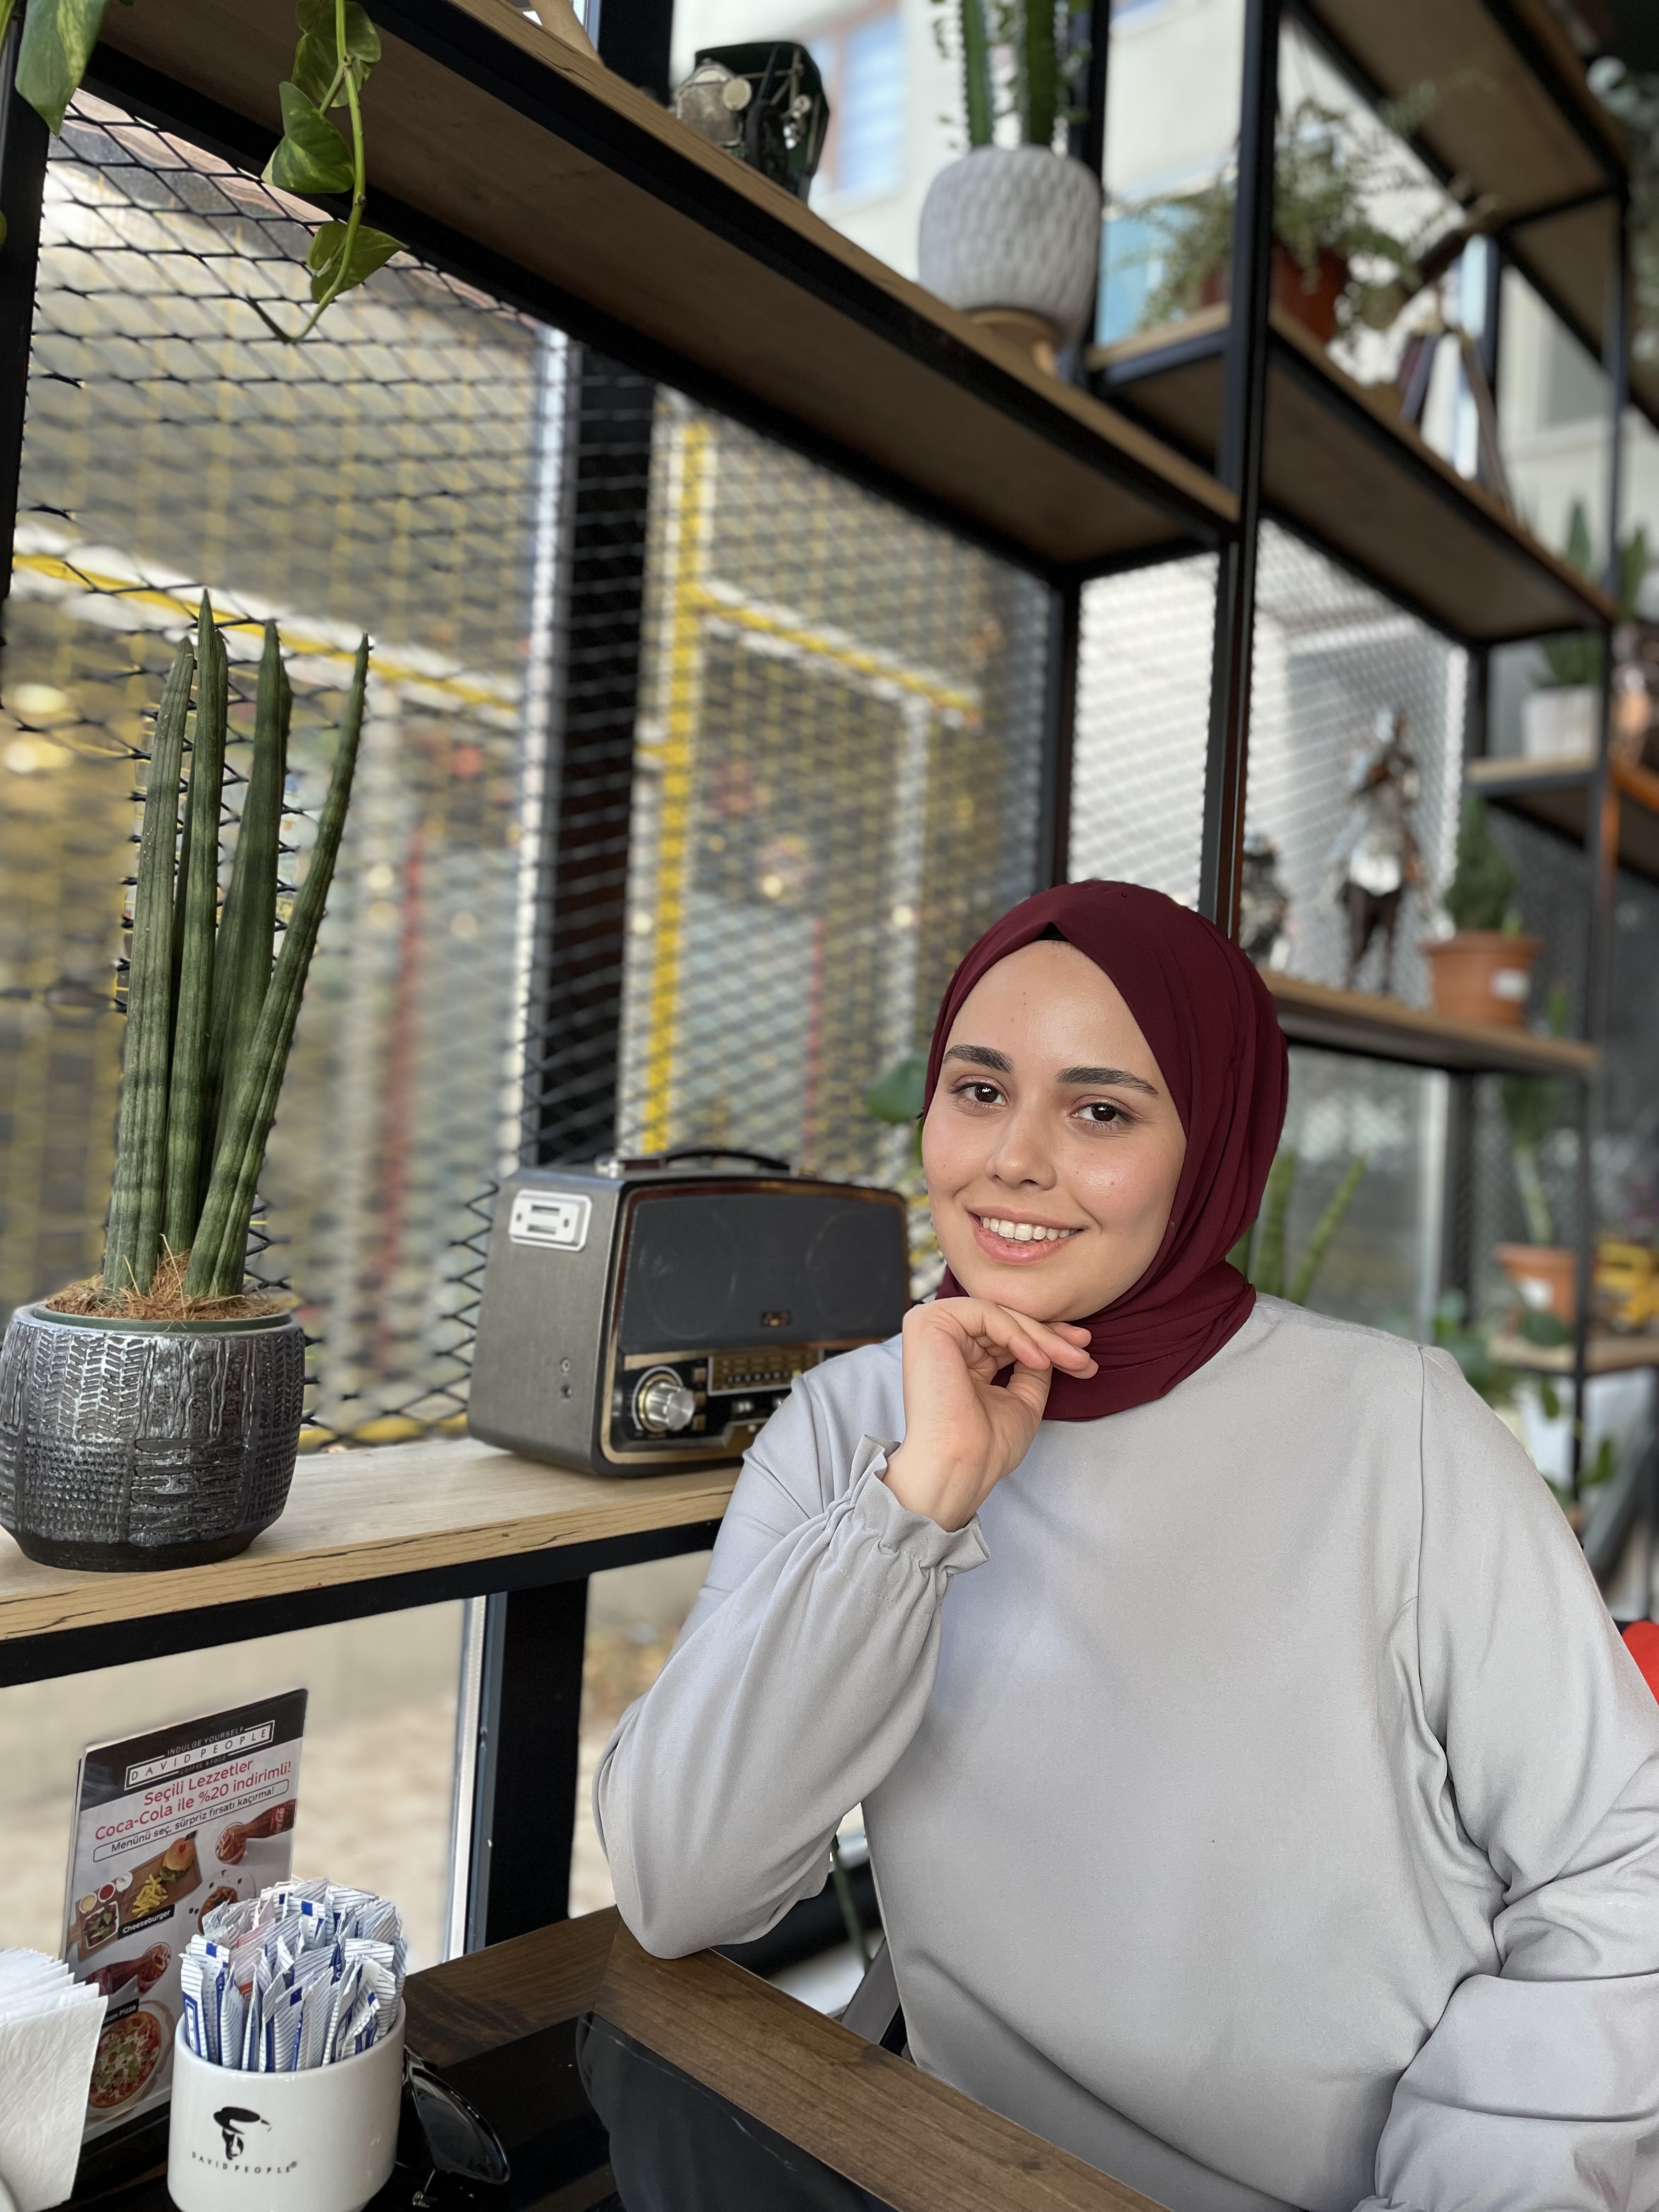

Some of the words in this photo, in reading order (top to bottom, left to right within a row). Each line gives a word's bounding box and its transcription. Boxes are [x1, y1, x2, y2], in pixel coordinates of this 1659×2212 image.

[131, 1754, 191, 1781] DAVID
[200, 1729, 266, 1758] PEOPLE
[167, 1740, 201, 1756] INDULGE
[204, 1726, 245, 1743] YOURSELF
[179, 1763, 203, 1775] COFFEE
[210, 1756, 226, 1765] FOOD
[144, 1780, 184, 1806] Seçili
[189, 1760, 253, 1791] Lezzetler
[95, 1805, 173, 1840] Coca-Cola
[178, 1798, 194, 1812] ile
[199, 1784, 229, 1804] %20
[233, 1761, 291, 1792] indirimli!
[111, 1832, 151, 1852] Menünü
[153, 1826, 172, 1837] seç,
[174, 1812, 207, 1830] sürpriz
[209, 1803, 235, 1818] fırsatı
[238, 1787, 275, 1807] kaçırma!
[122, 1910, 171, 1934] Cheeseburger
[119, 2005, 136, 2017] Pizza
[192, 2151, 228, 2170] DAVID
